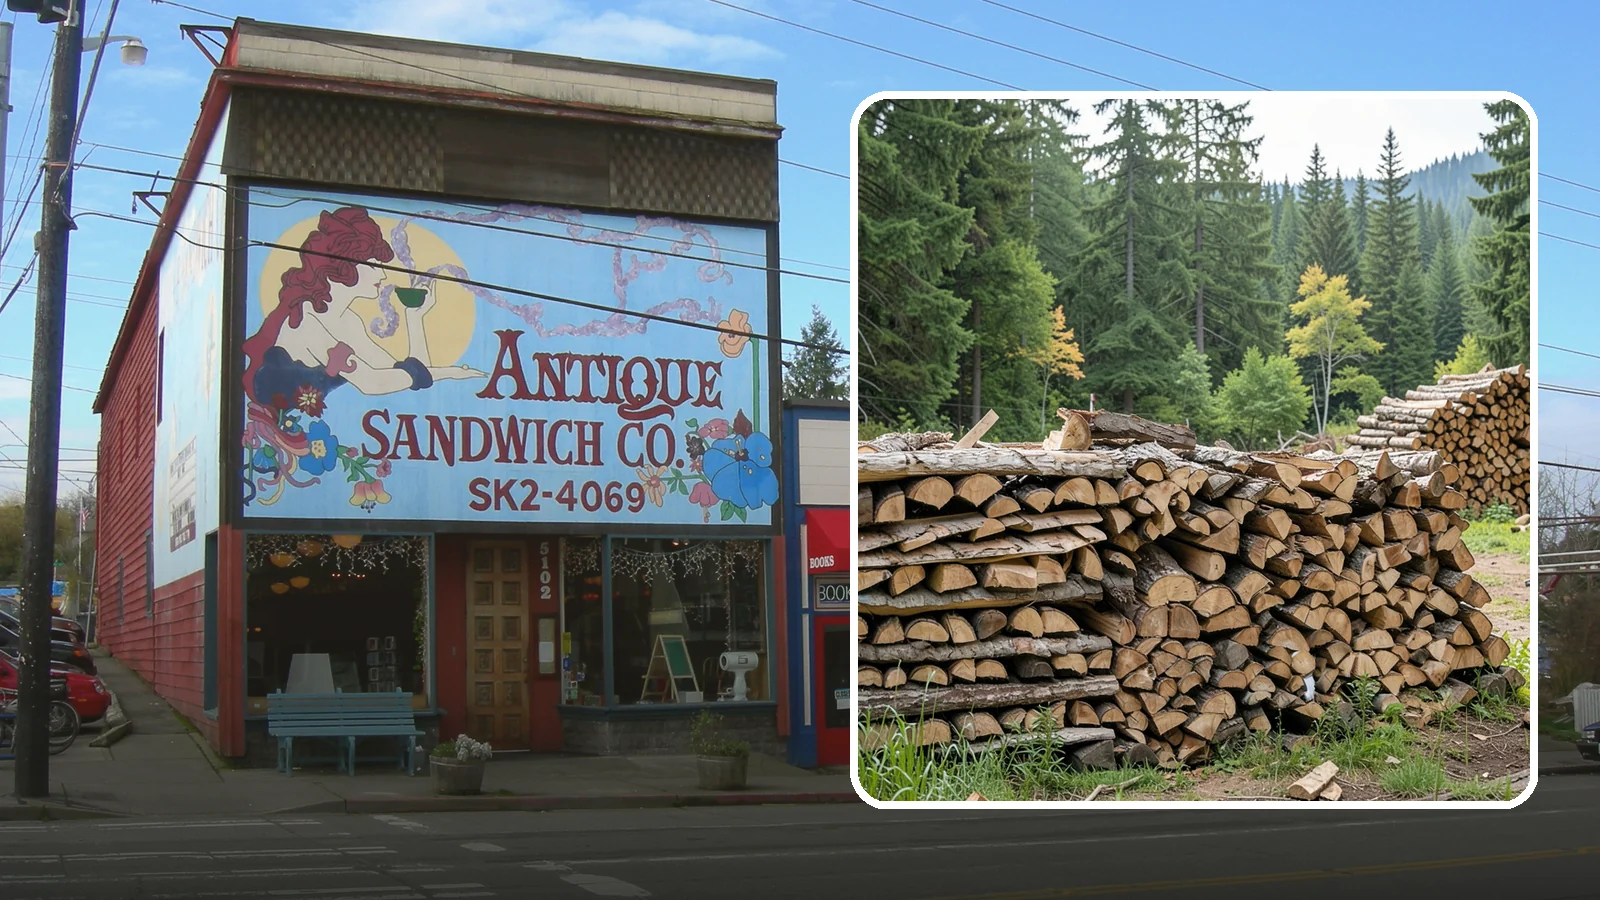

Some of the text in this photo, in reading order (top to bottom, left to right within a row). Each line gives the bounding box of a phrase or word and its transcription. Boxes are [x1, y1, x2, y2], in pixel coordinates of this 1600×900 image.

[476, 329, 723, 422] ANTIQUE
[361, 409, 685, 469] SANDWICH CO.
[468, 478, 646, 513] SK2-4069
[540, 541, 552, 600] 5102
[809, 554, 835, 569] BOOKS
